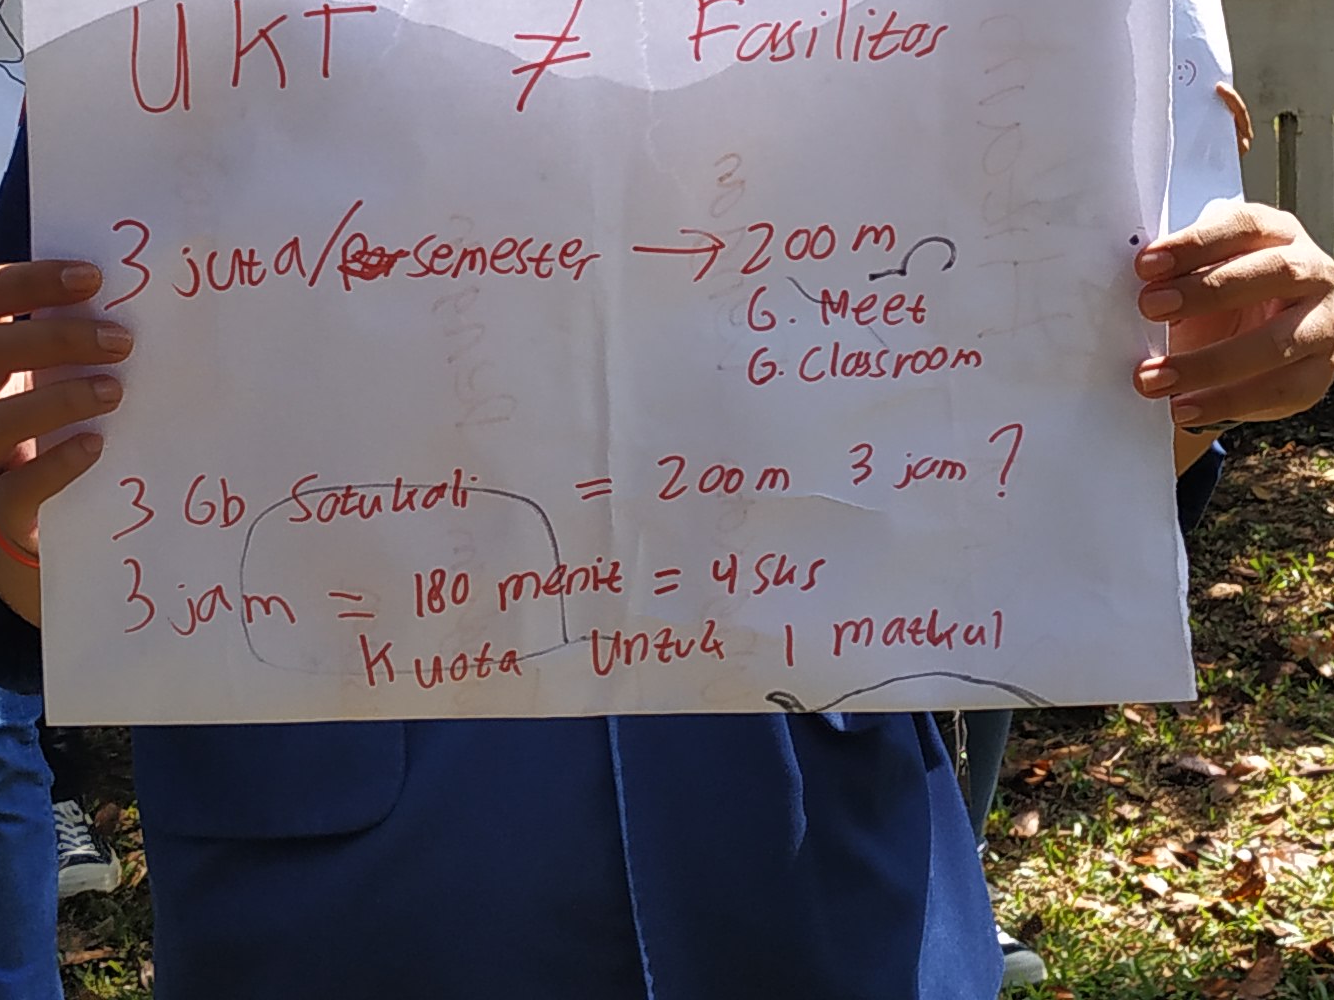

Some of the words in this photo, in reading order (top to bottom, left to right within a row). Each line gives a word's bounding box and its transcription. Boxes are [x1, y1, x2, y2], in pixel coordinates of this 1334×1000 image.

[104, 218, 151, 311] 3
[819, 288, 928, 327] Meet
[112, 477, 155, 541] 3
[848, 442, 874, 487] 3
[123, 557, 155, 634] 3
[167, 582, 297, 636] jam
[413, 568, 470, 618] 180
[498, 556, 624, 612] menit
[359, 632, 523, 690] Kuota
[832, 609, 1004, 657] matkul
